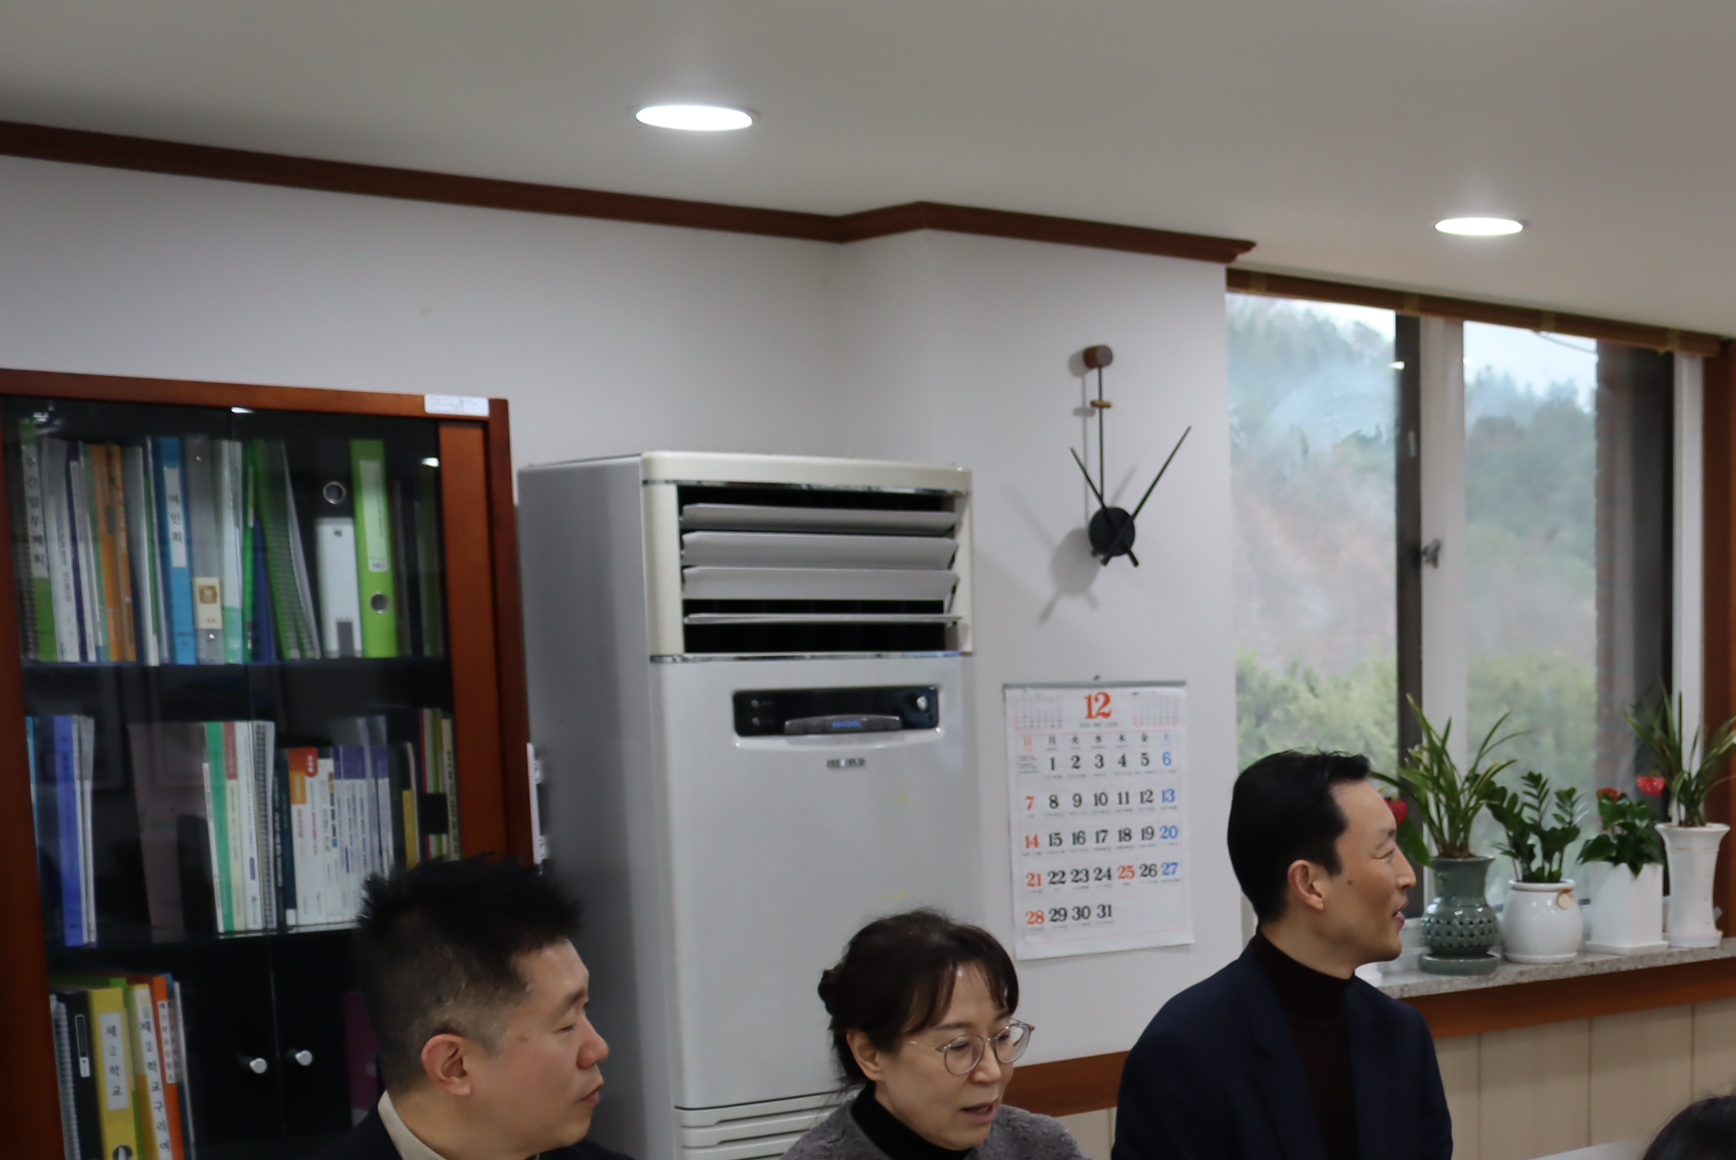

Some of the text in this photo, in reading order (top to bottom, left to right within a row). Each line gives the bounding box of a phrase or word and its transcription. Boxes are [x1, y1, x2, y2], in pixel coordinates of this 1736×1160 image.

[1083, 691, 1113, 719] 12
[1118, 733, 1126, 743] 木
[1049, 756, 1056, 771] 1
[1070, 755, 1081, 769] 2
[1094, 754, 1104, 769] 3
[1117, 753, 1127, 768] 4
[1140, 752, 1150, 767] 5
[1162, 751, 1172, 766] 6
[1025, 788, 1176, 811] 7 8 9 10 11 12 13
[1025, 825, 1179, 849] 14 15 16 17 18 19 20
[1025, 862, 1179, 887] 21 22 23 24 25 26 27
[1025, 904, 1113, 925] 28 29 30 31
